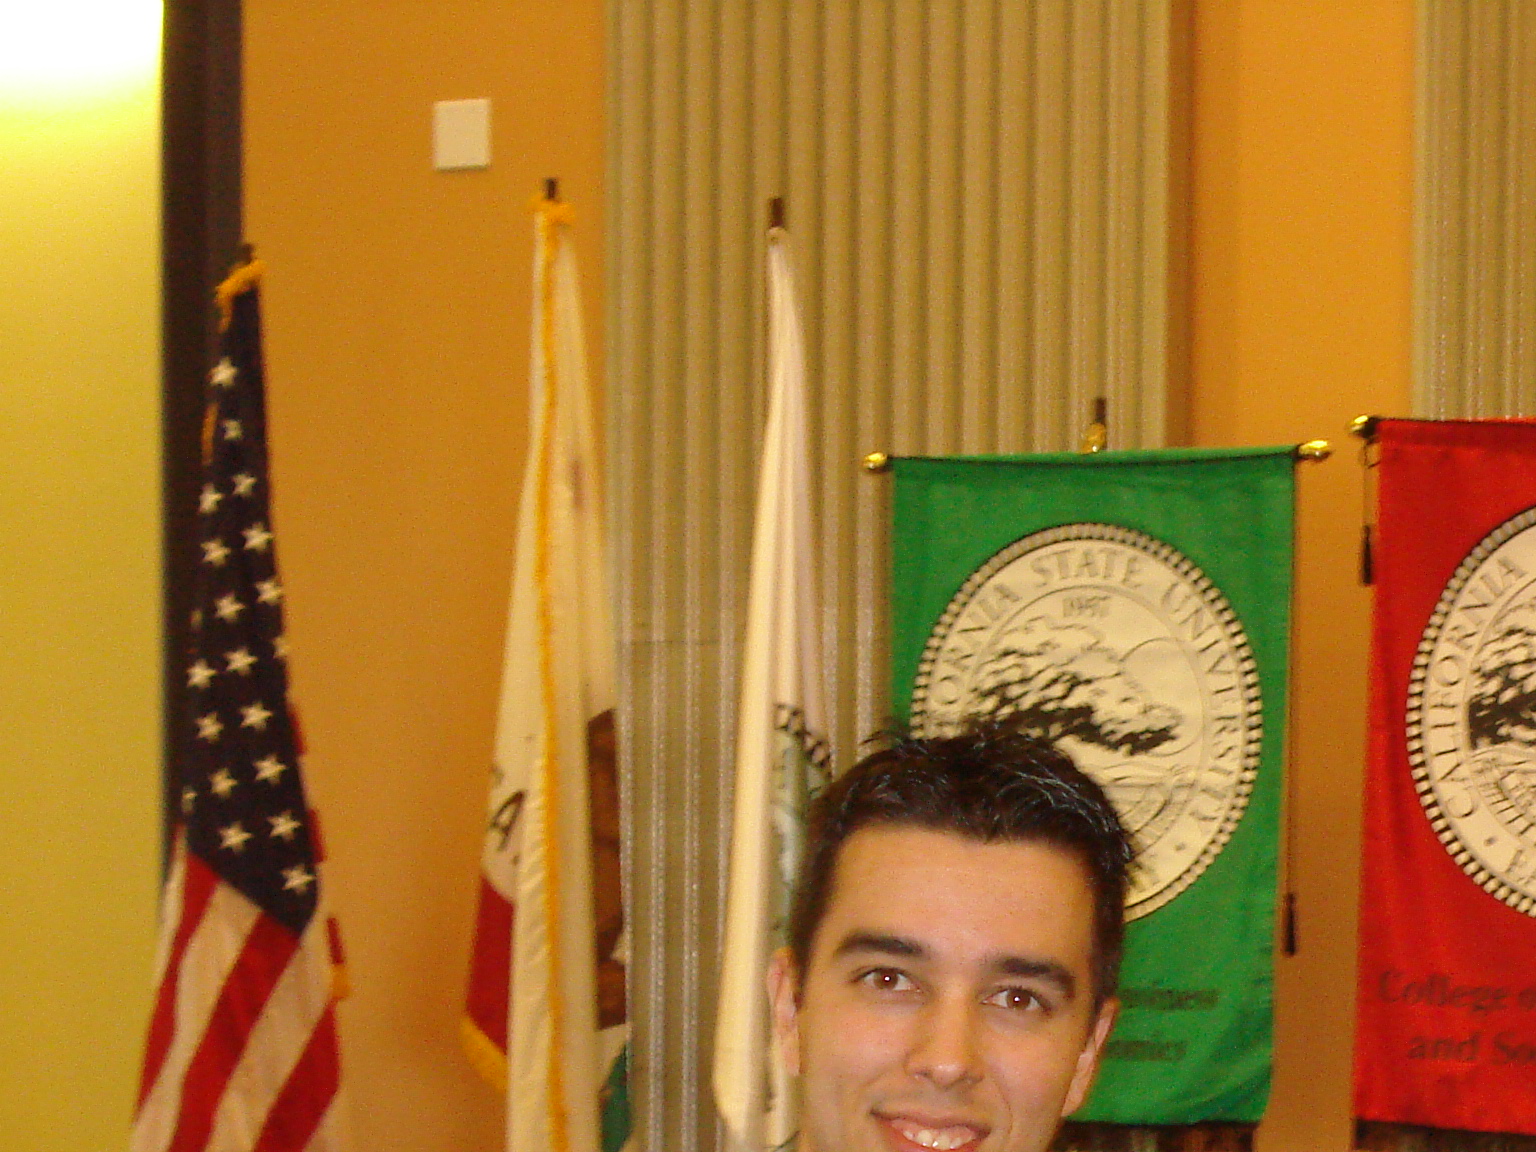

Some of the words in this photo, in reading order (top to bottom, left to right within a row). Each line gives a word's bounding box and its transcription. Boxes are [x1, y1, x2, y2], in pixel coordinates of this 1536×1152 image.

[1031, 548, 1144, 587] STATE
[1161, 582, 1234, 823] UNIVERSITY
[1430, 554, 1529, 818] CALIFORNIA
[1378, 970, 1508, 1016] College
[1408, 1032, 1482, 1062] and
